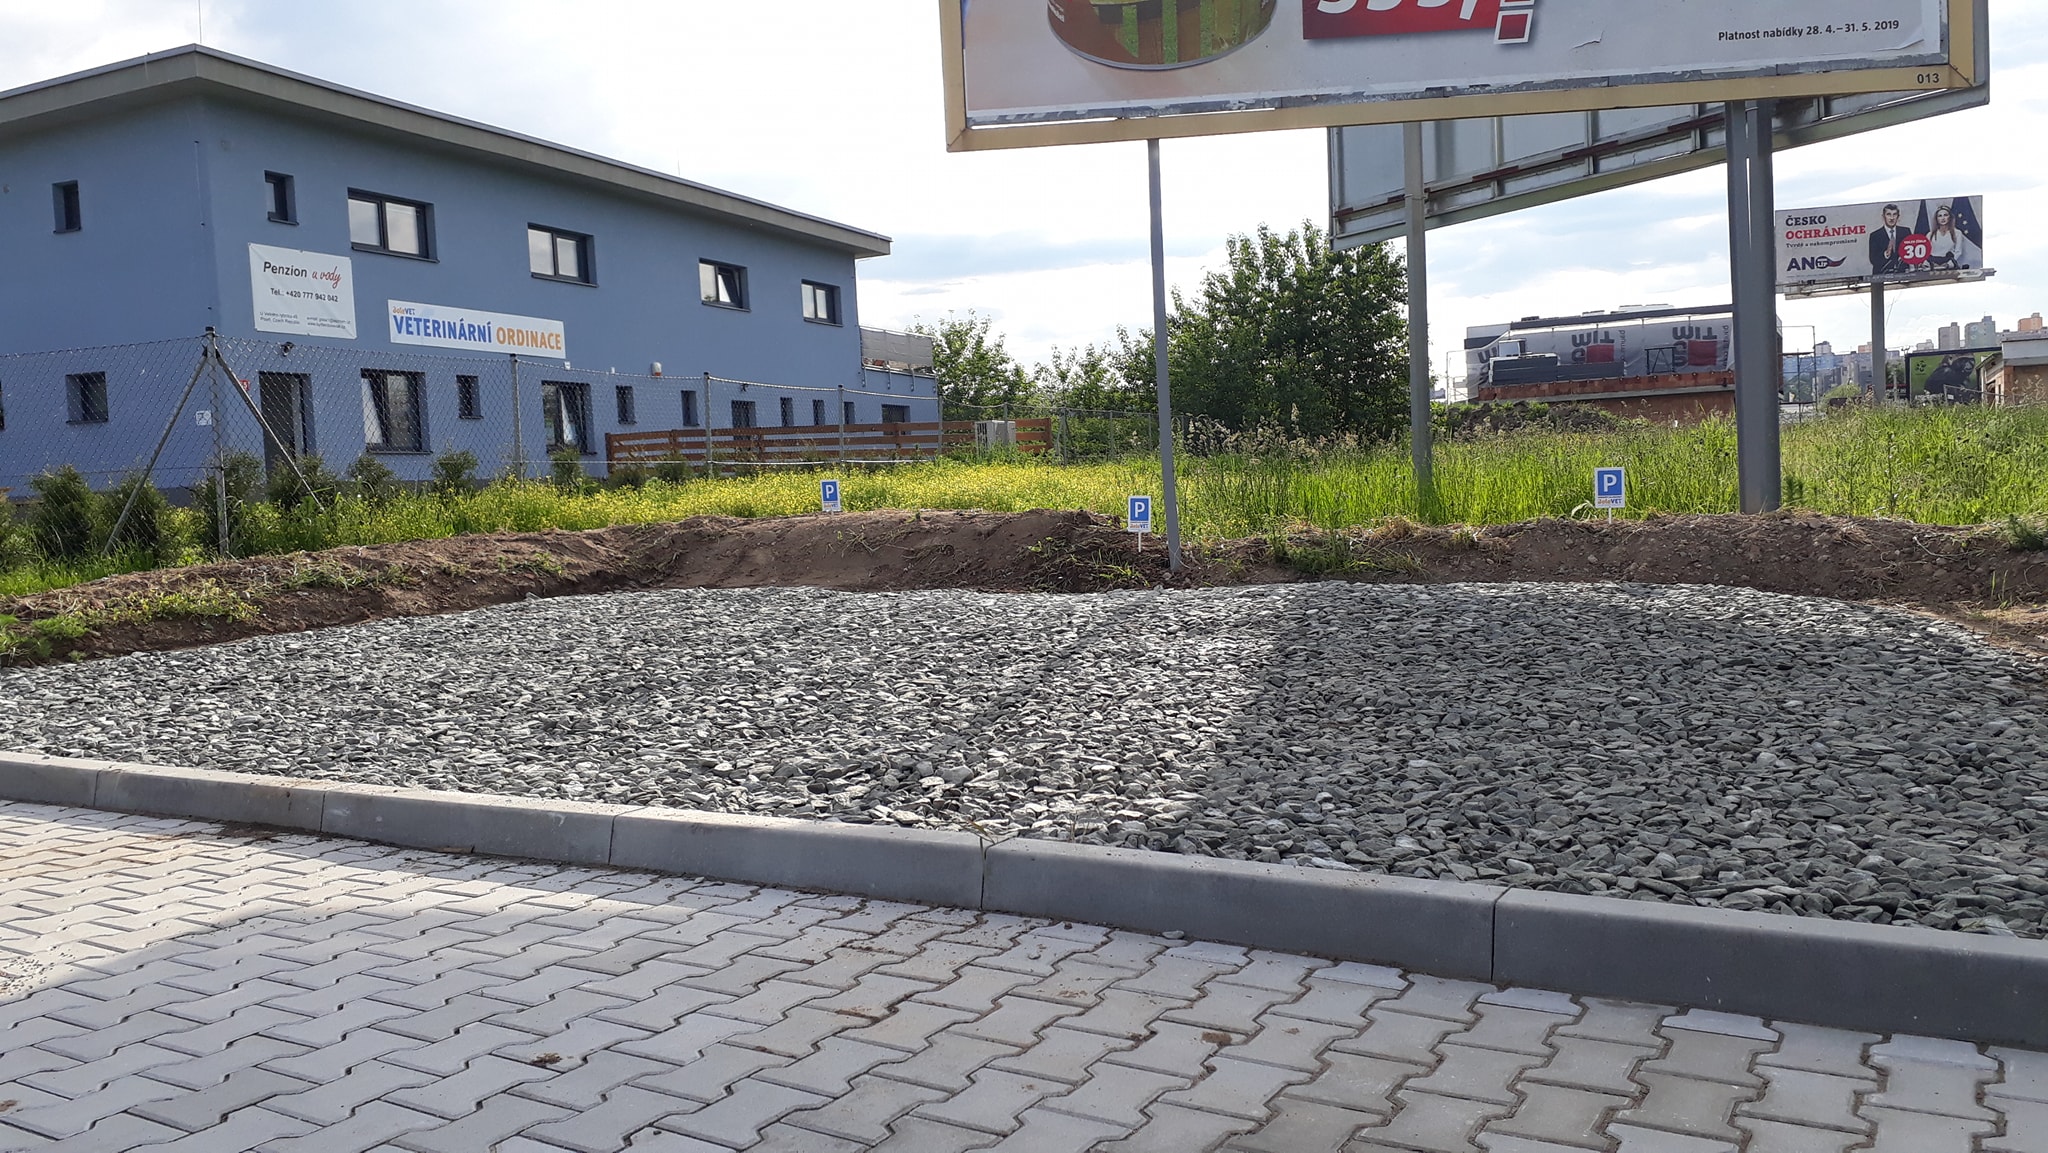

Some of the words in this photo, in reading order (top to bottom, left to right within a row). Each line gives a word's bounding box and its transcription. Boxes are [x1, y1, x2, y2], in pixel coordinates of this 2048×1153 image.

[1718, 30, 1760, 41] Platnost
[1763, 27, 1803, 38] nabídky
[1806, 26, 1823, 35] 28.
[1874, 20, 1900, 31] 2019
[1916, 73, 1940, 84] 013
[1785, 214, 1827, 227] ČESKO
[1785, 225, 1866, 240] OCHRÁNÍME
[1903, 244, 1926, 259] 30
[263, 261, 308, 278] Penzion
[319, 266, 342, 289] vody
[286, 290, 301, 298] +420
[303, 291, 314, 300] 777
[315, 293, 327, 301] 942
[327, 295, 339, 303] 042
[393, 315, 492, 343] VETERINÁRNÍ
[496, 327, 562, 350] ORDINACE
[1603, 474, 1617, 492] P
[826, 484, 834, 499] P
[1134, 501, 1146, 518] P
